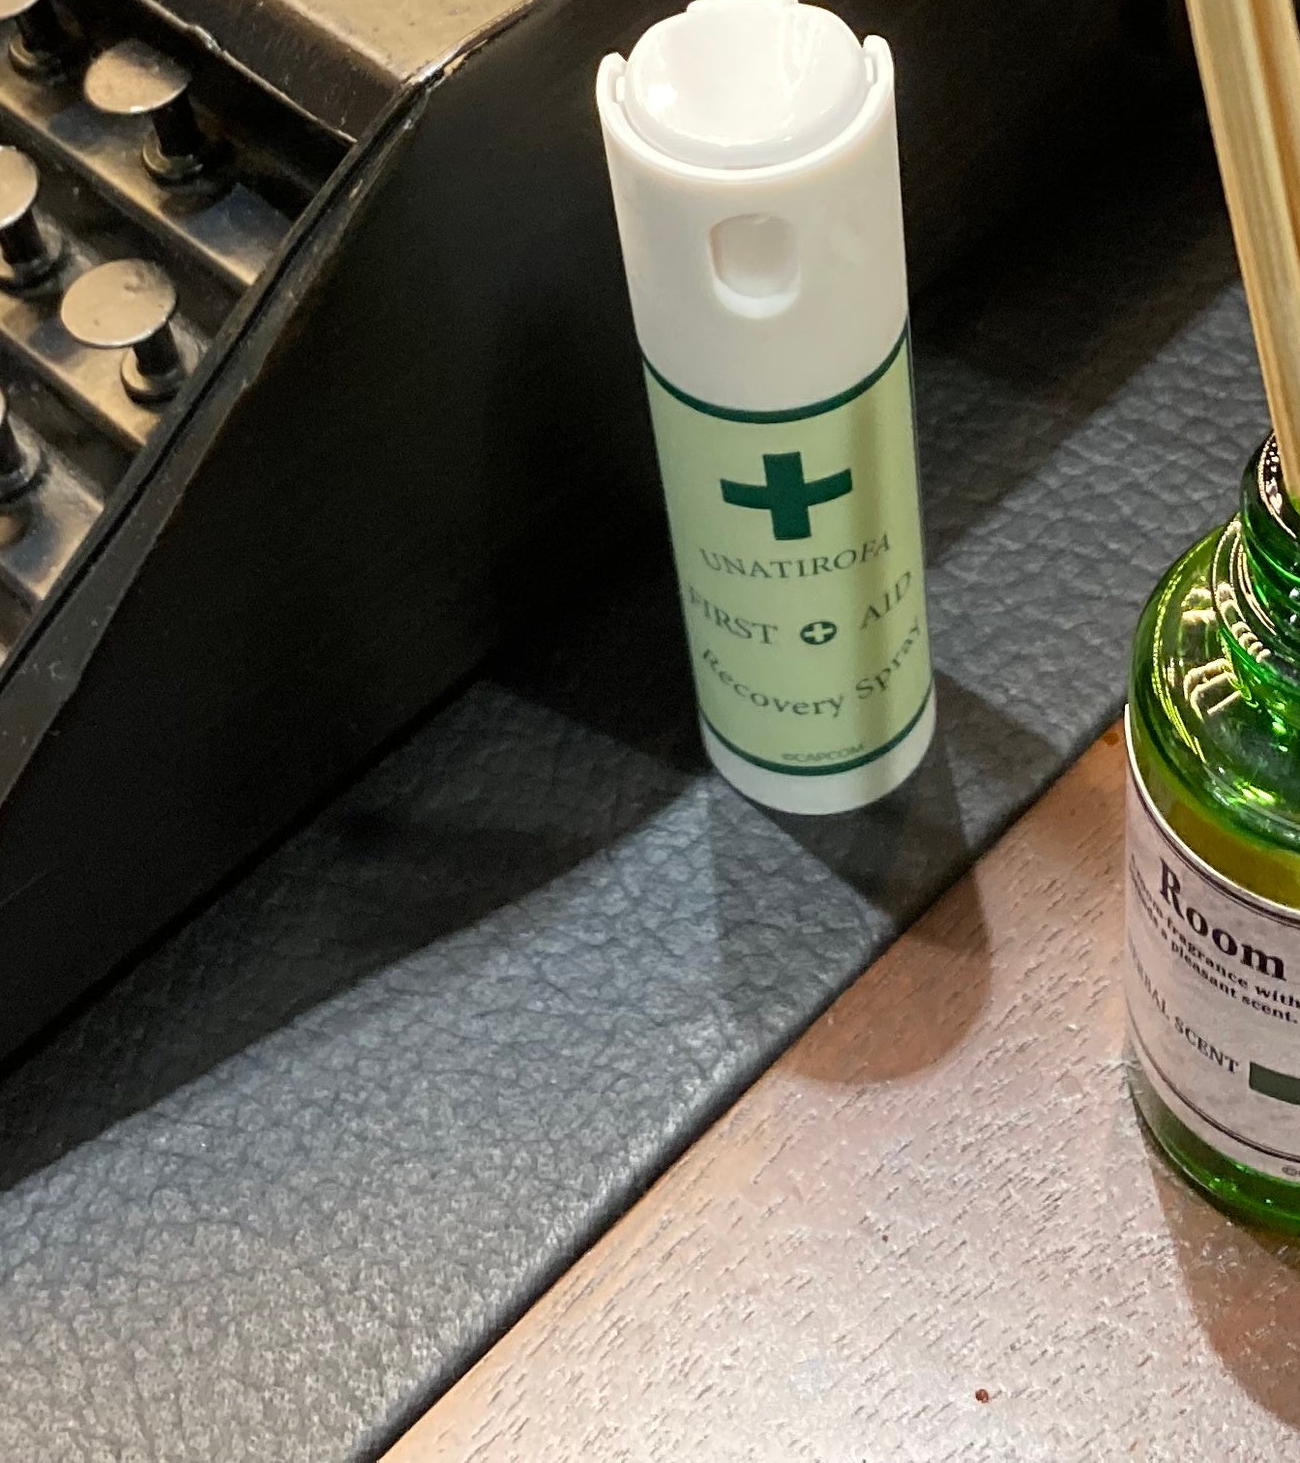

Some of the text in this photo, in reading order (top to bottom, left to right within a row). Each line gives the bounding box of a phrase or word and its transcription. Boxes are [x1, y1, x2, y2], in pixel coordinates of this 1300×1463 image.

[687, 570, 912, 644] FIRST AID
[703, 617, 921, 718] Recovery Spray
[1160, 856, 1287, 981] Room
[1167, 915, 1248, 989] fragrance
[1255, 985, 1300, 1009] with
[1170, 939, 1238, 1000] pleasant
[1241, 994, 1298, 1024] scent.
[1174, 1015, 1240, 1075] SCENT
